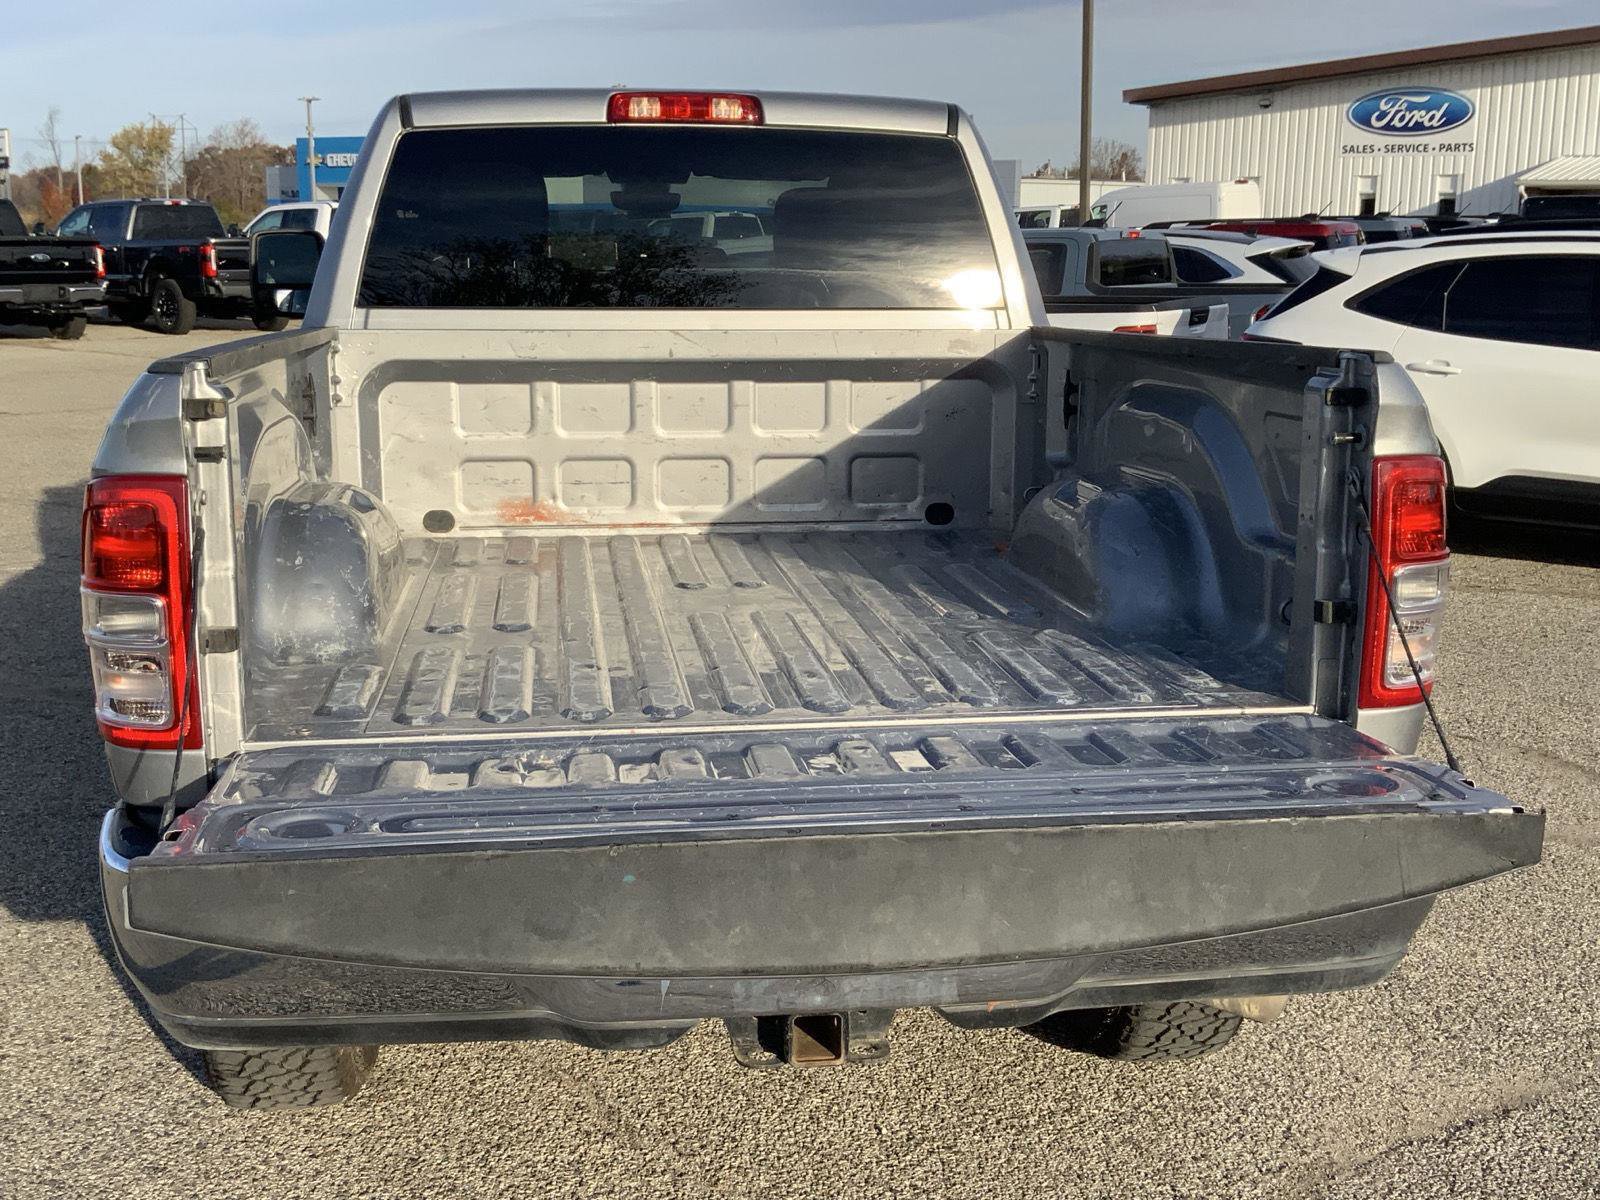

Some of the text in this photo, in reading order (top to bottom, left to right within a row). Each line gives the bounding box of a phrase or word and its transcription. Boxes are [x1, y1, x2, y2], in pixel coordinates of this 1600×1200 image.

[1370, 95, 1449, 128] Ford
[1342, 142, 1474, 154] SALES SERVICE PARTS
